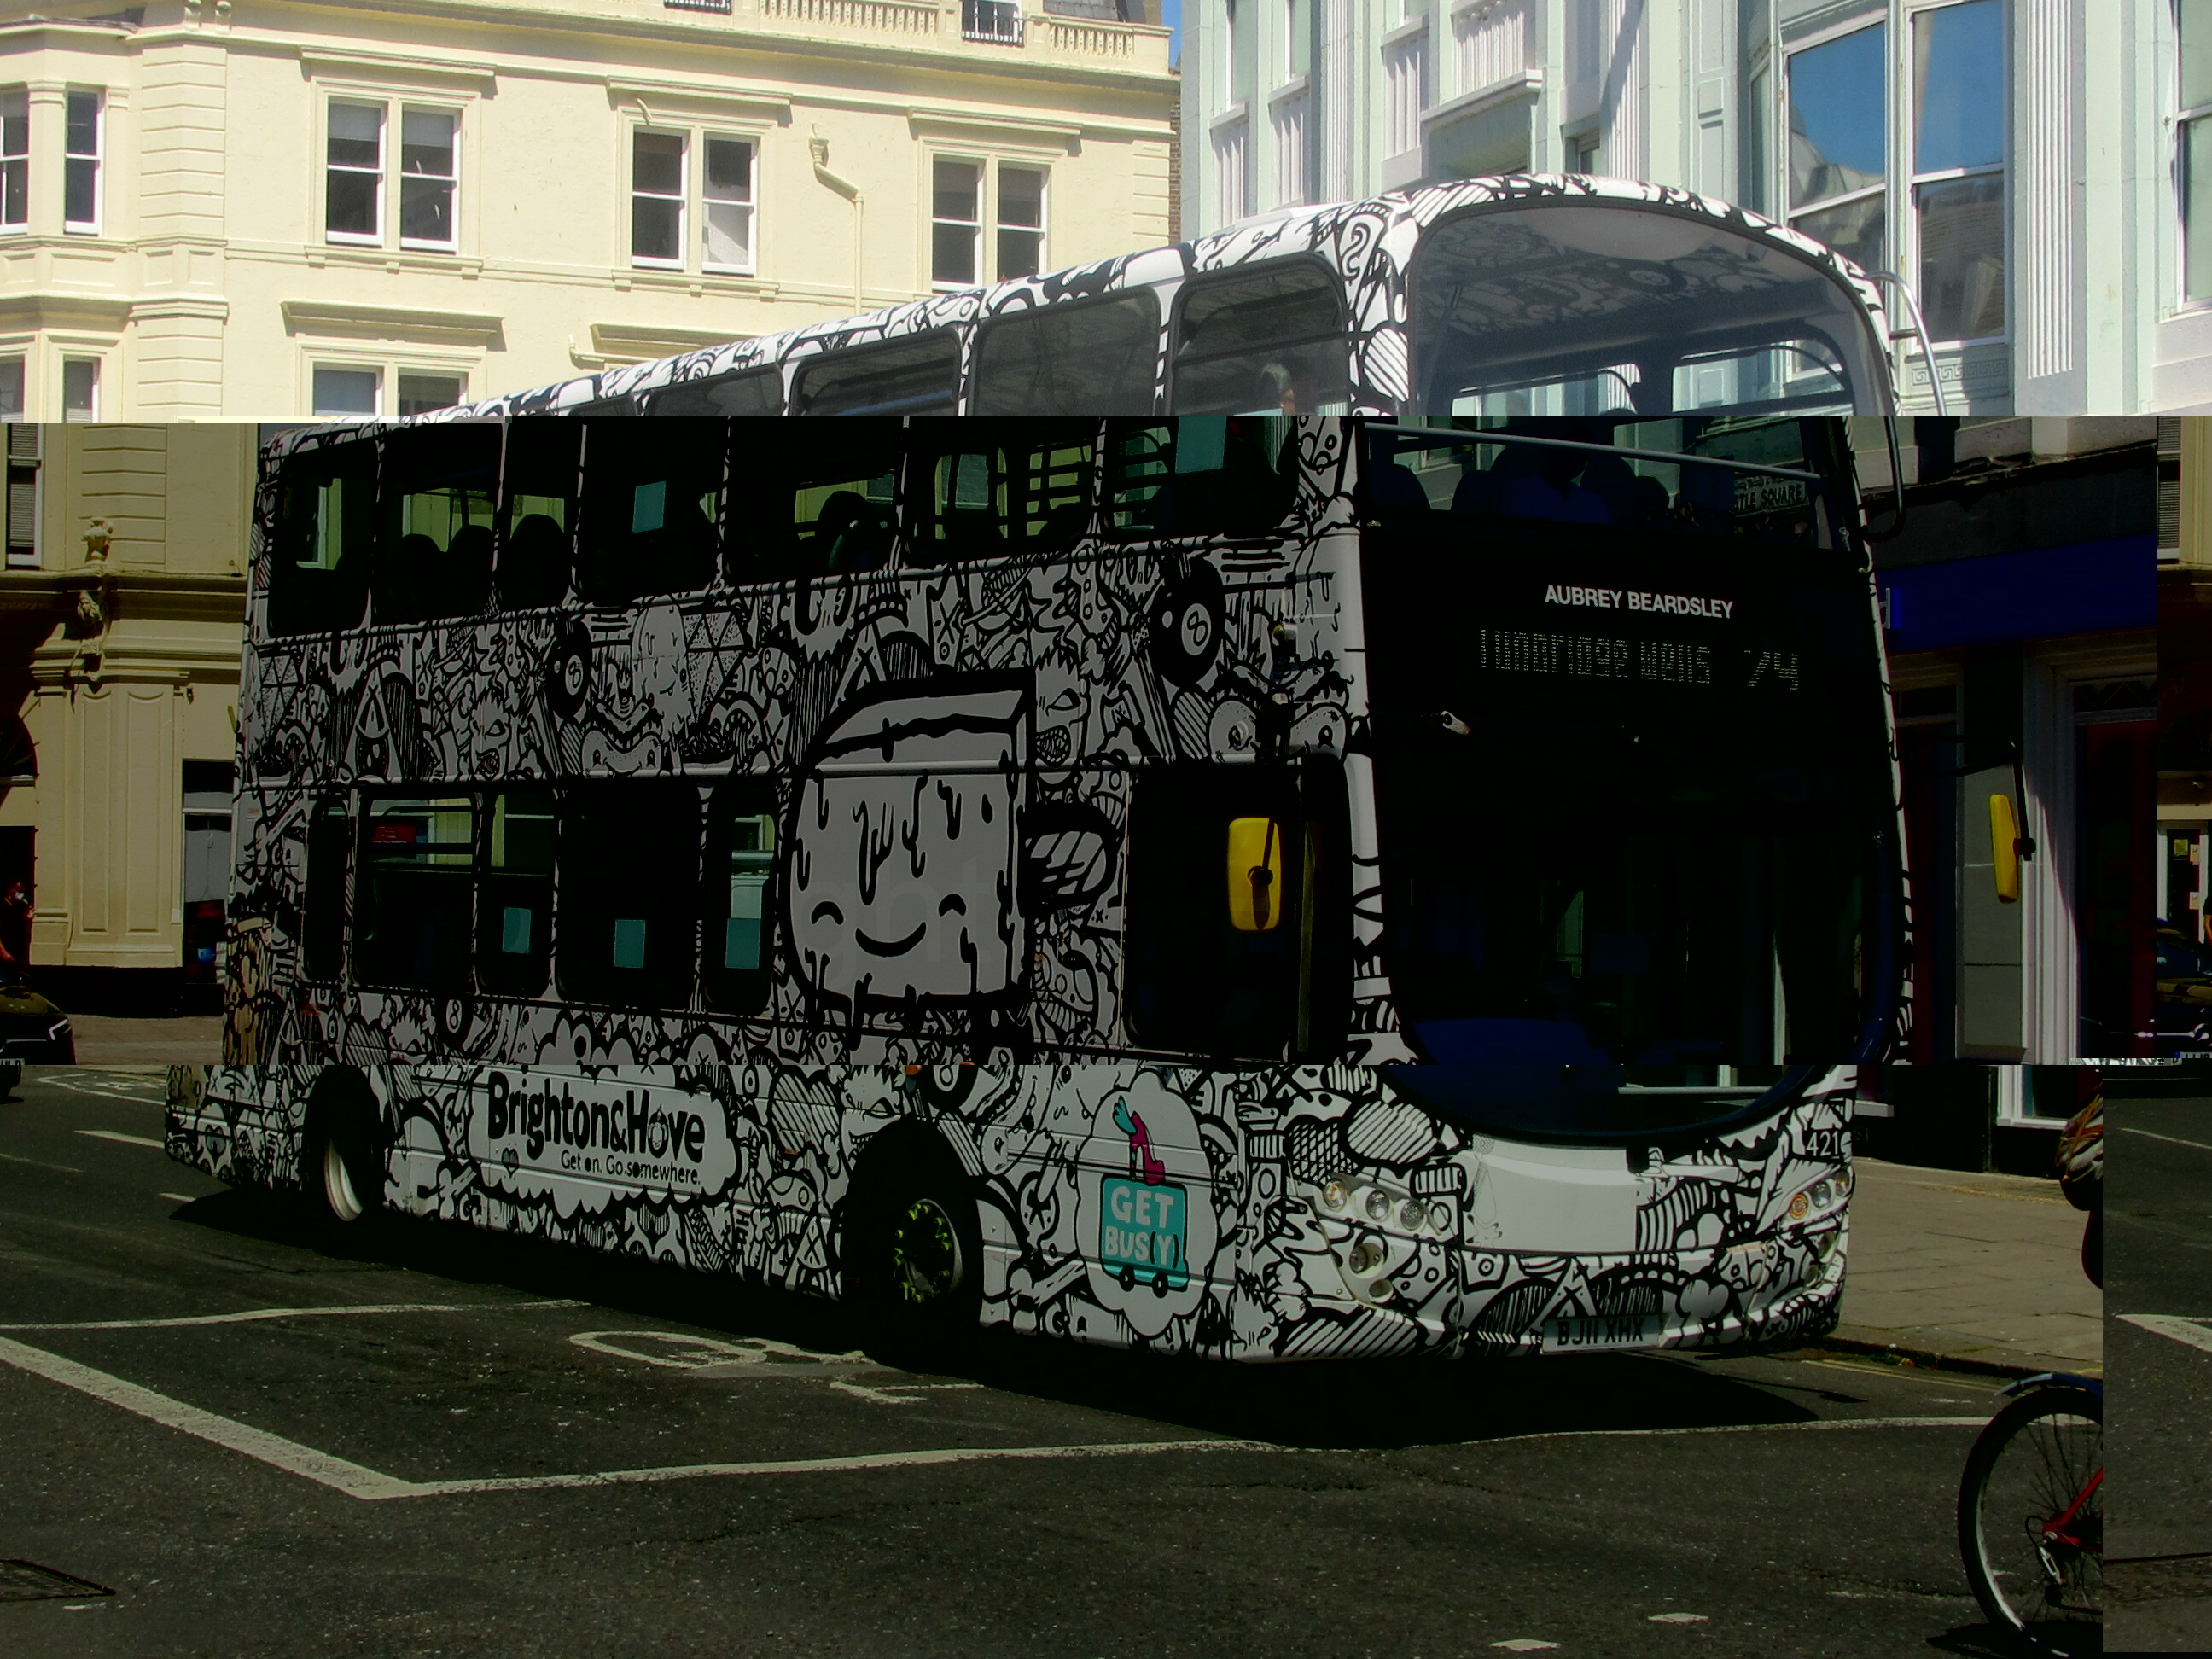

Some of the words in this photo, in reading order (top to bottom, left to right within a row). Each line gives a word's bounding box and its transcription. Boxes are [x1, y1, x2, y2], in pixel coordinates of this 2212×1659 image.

[1761, 484, 1802, 508] SQUARE
[1544, 585, 1622, 609] AUBREY
[1627, 591, 1733, 619] BEARDSLEY
[561, 1150, 581, 1171] Get
[584, 1156, 602, 1173] on.
[1110, 1185, 1175, 1229] GET
[1105, 1225, 1179, 1269] BUS(Y)
[1557, 1319, 1599, 1346] BJ11
[1605, 1317, 1644, 1343] XHX
